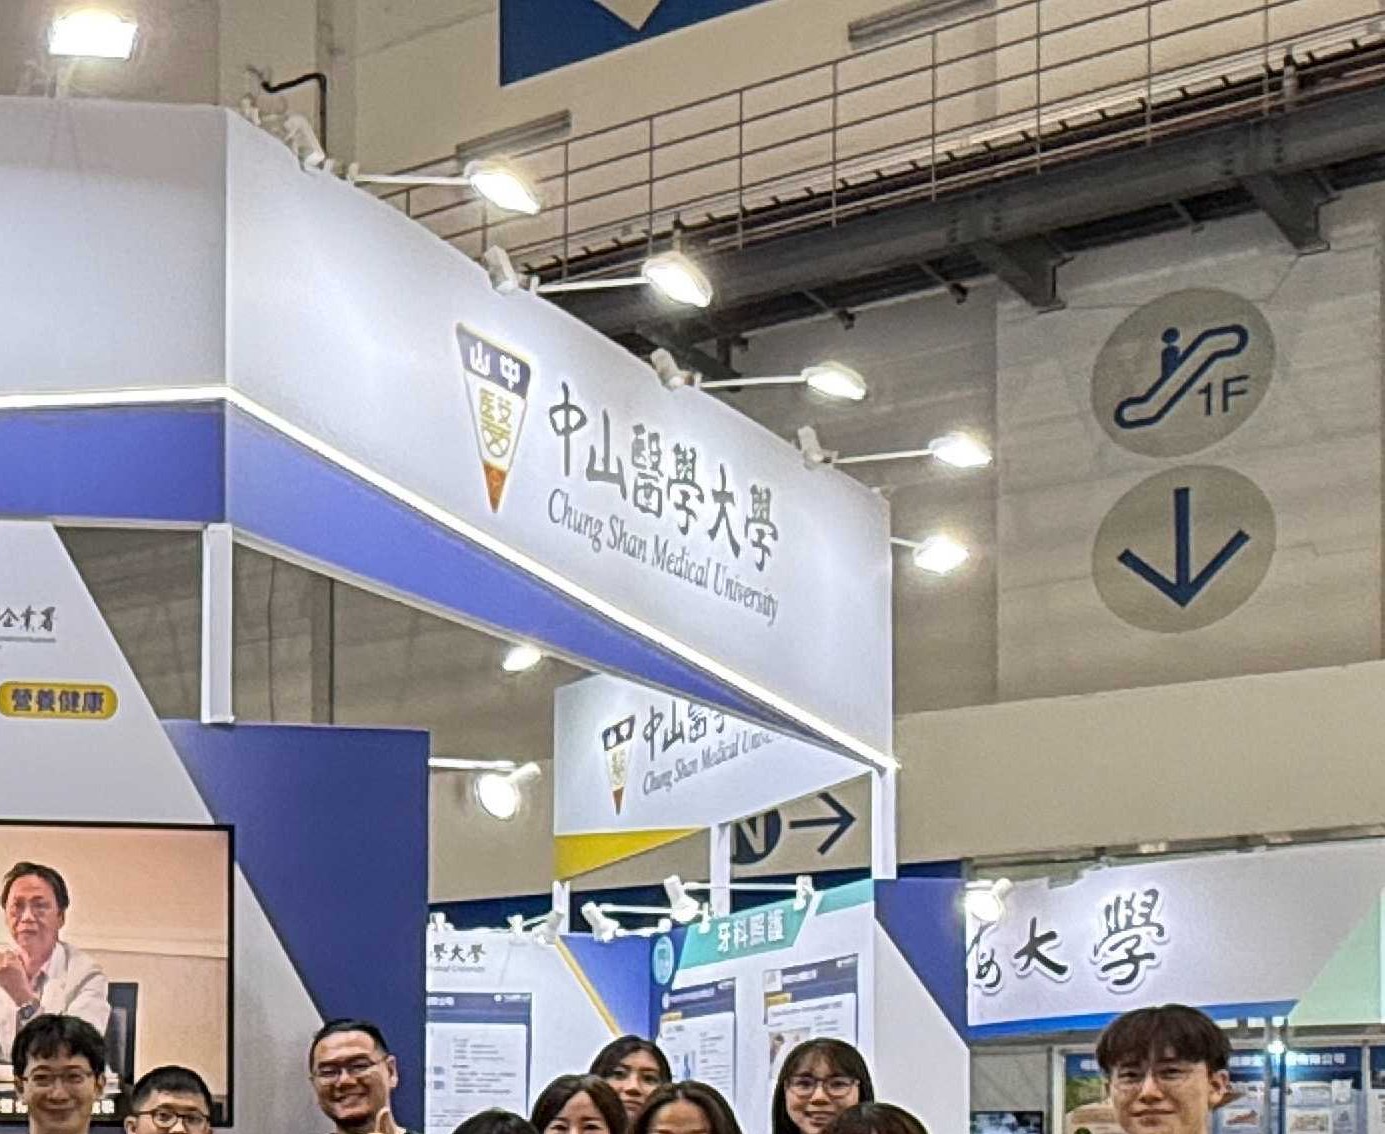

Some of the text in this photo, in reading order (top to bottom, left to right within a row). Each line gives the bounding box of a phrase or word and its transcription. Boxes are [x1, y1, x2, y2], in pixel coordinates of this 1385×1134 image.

[1198, 374, 1250, 416] 1F
[548, 381, 779, 572] 中山醫學大學
[548, 488, 779, 627] Chung Shan Medical University
